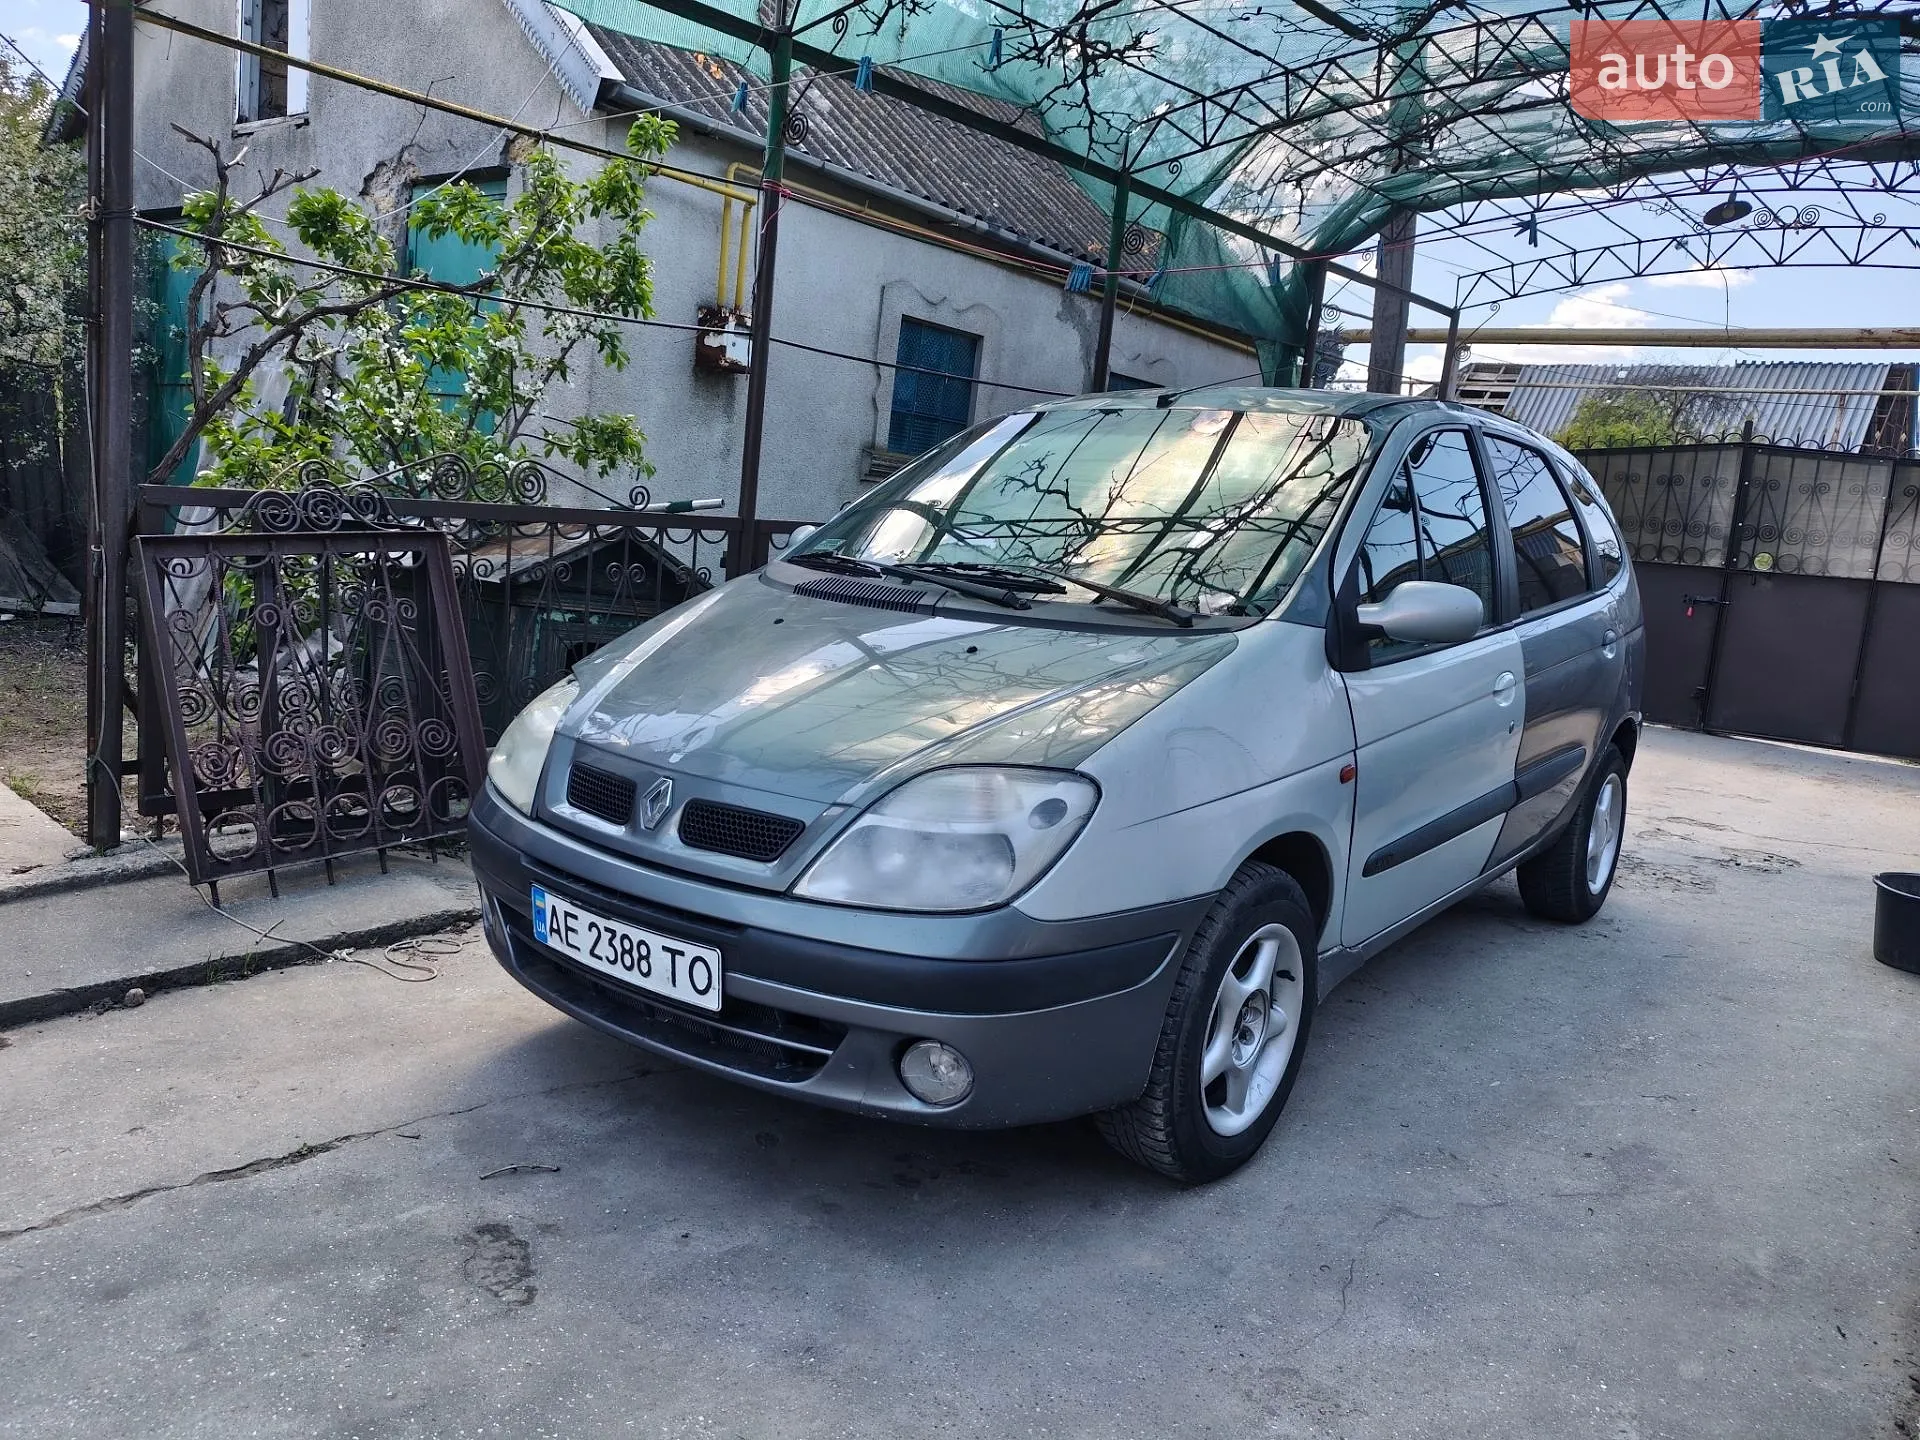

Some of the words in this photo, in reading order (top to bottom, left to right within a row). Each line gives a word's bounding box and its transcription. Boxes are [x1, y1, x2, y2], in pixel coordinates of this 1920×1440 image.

[537, 921, 546, 934] UA
[550, 905, 581, 952] AE
[588, 921, 651, 978] 2388
[662, 945, 712, 995] TO
